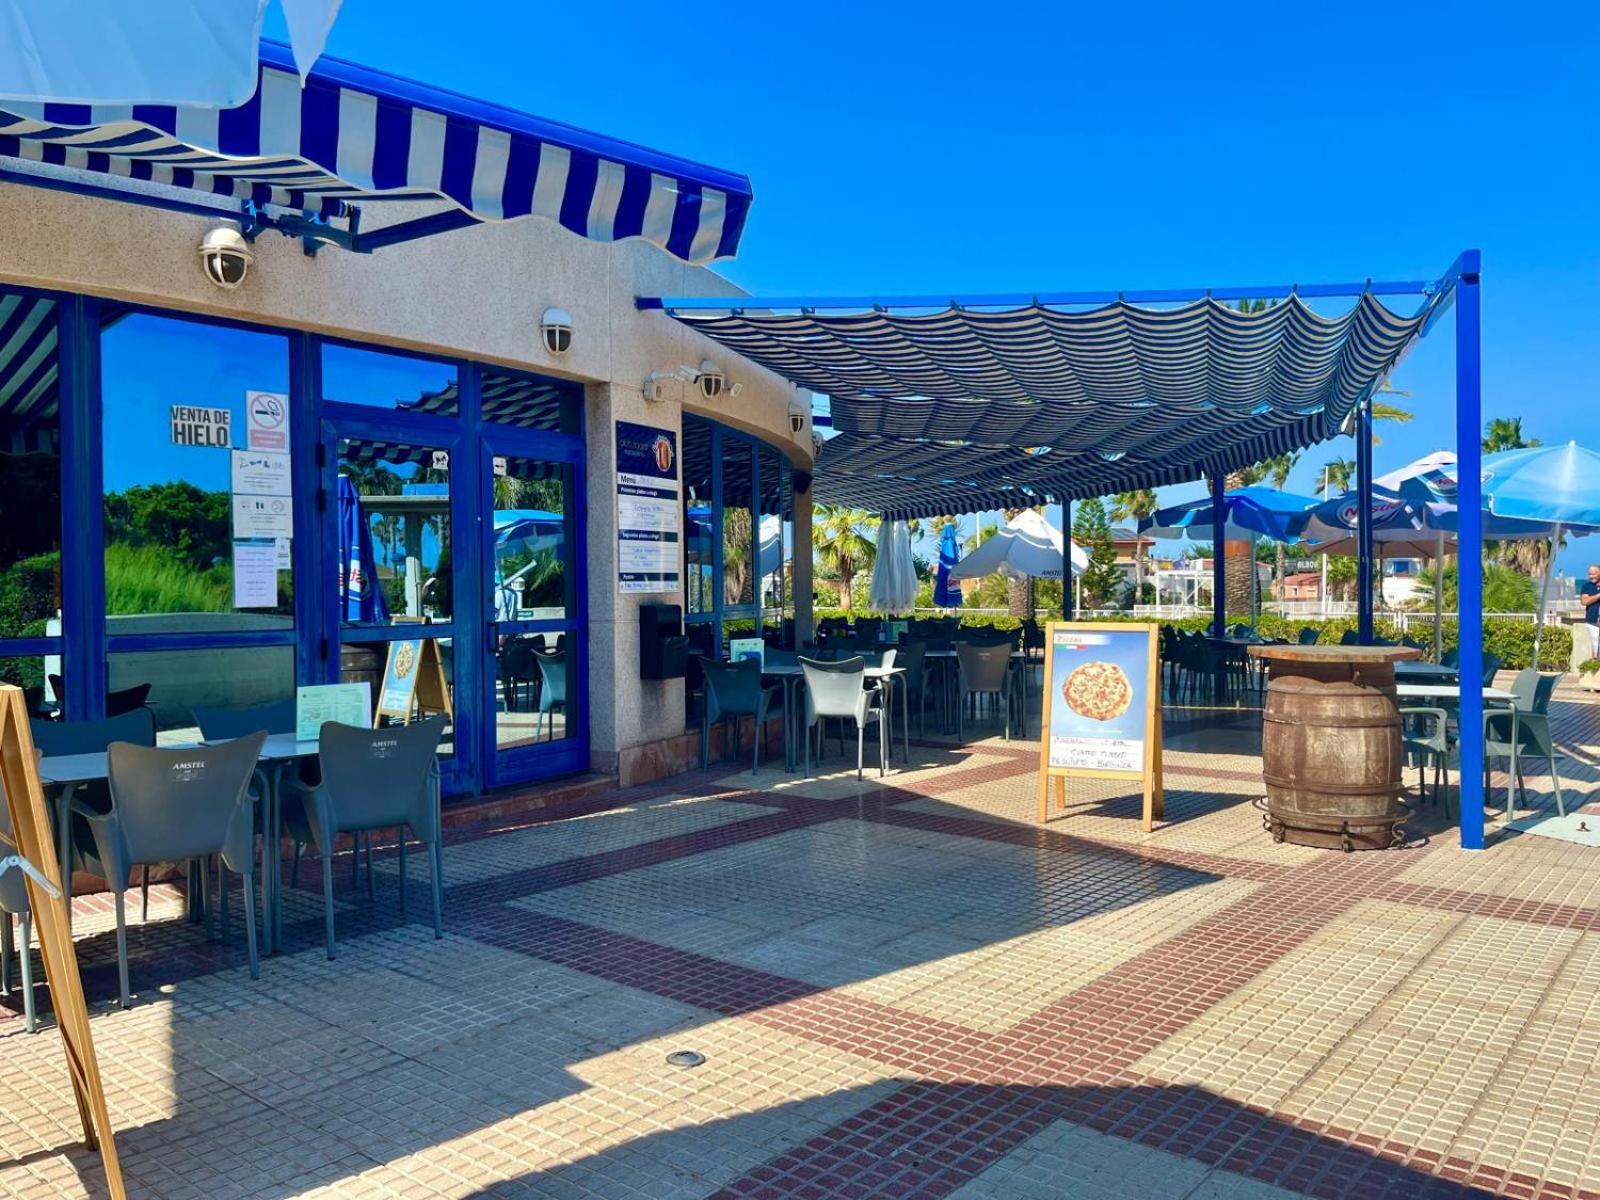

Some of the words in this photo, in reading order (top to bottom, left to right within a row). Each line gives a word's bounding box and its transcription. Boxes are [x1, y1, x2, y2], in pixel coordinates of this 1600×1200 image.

[171, 406, 211, 423] VENTA
[214, 410, 229, 424] DE
[173, 423, 228, 446] HIELO
[172, 761, 207, 770] AMSTEL
